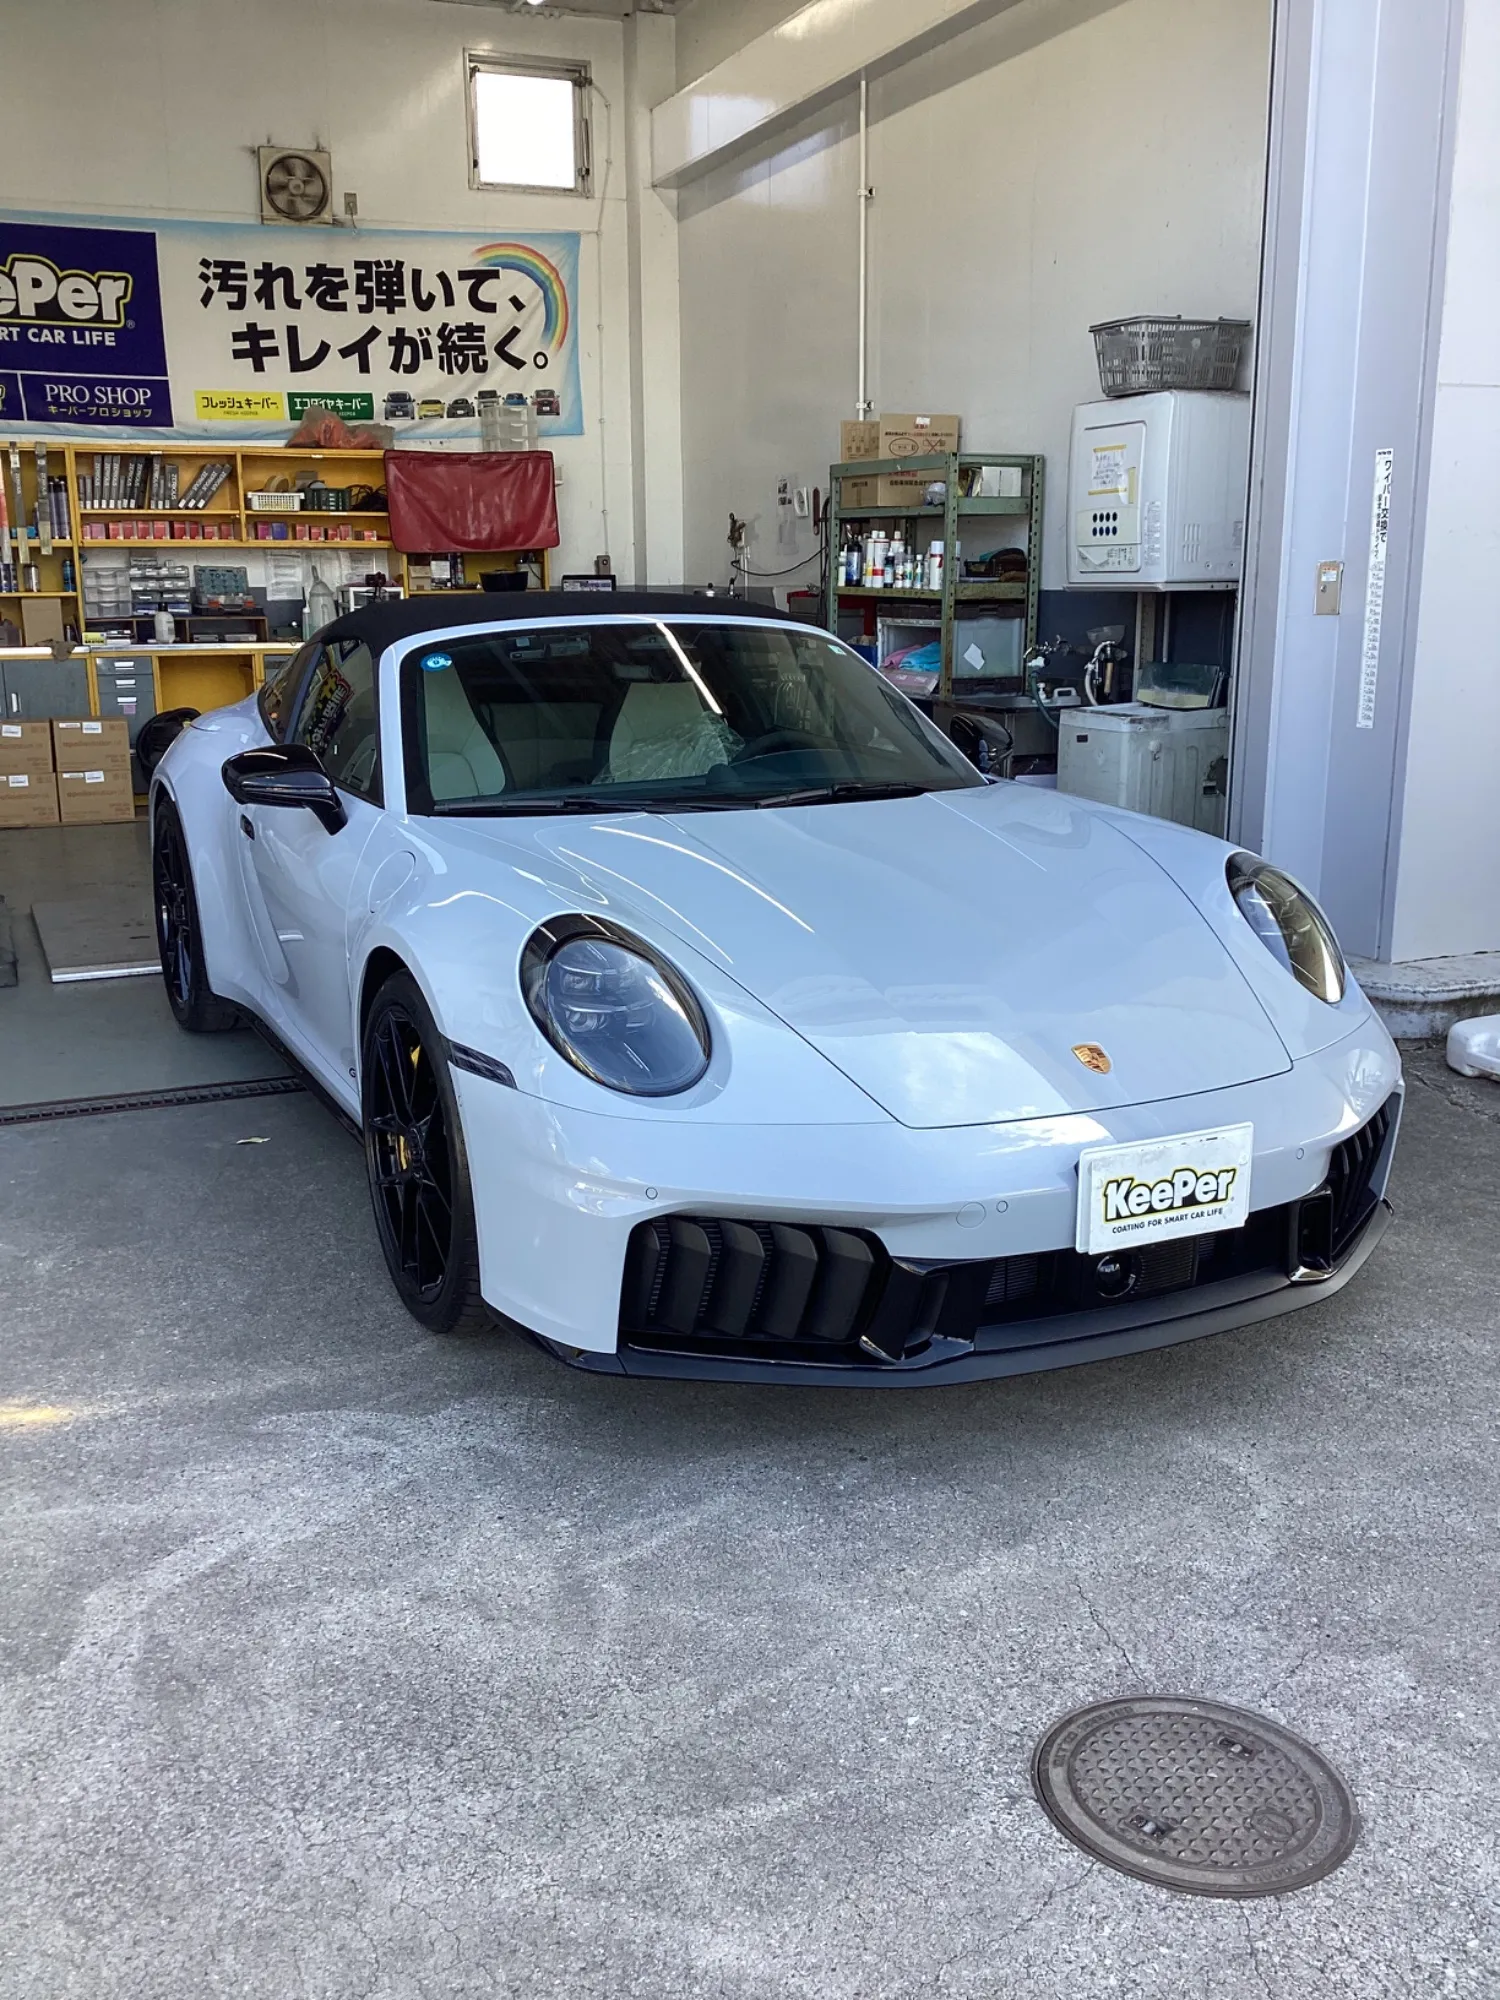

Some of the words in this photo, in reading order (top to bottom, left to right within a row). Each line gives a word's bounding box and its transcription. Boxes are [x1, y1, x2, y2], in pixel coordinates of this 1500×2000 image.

[199, 257, 528, 315] 汚れを弾いて、
[27, 328, 66, 344] CAR
[72, 331, 116, 346] LIFE
[231, 321, 549, 375] キレイが続く。
[45, 384, 90, 403] PRO
[95, 387, 151, 406] SHOP
[201, 396, 278, 410] フレッシュキーパー
[48, 405, 152, 418] キーパープロショップ
[1380, 459, 1392, 543] ワイパー交換で
[1104, 1167, 1237, 1222] KeePer
[1112, 1221, 1145, 1234] COATING
[1148, 1218, 1162, 1228] FOR
[1164, 1214, 1188, 1225] SMART
[1190, 1210, 1205, 1220] CAR
[1207, 1208, 1223, 1218] LIFE
